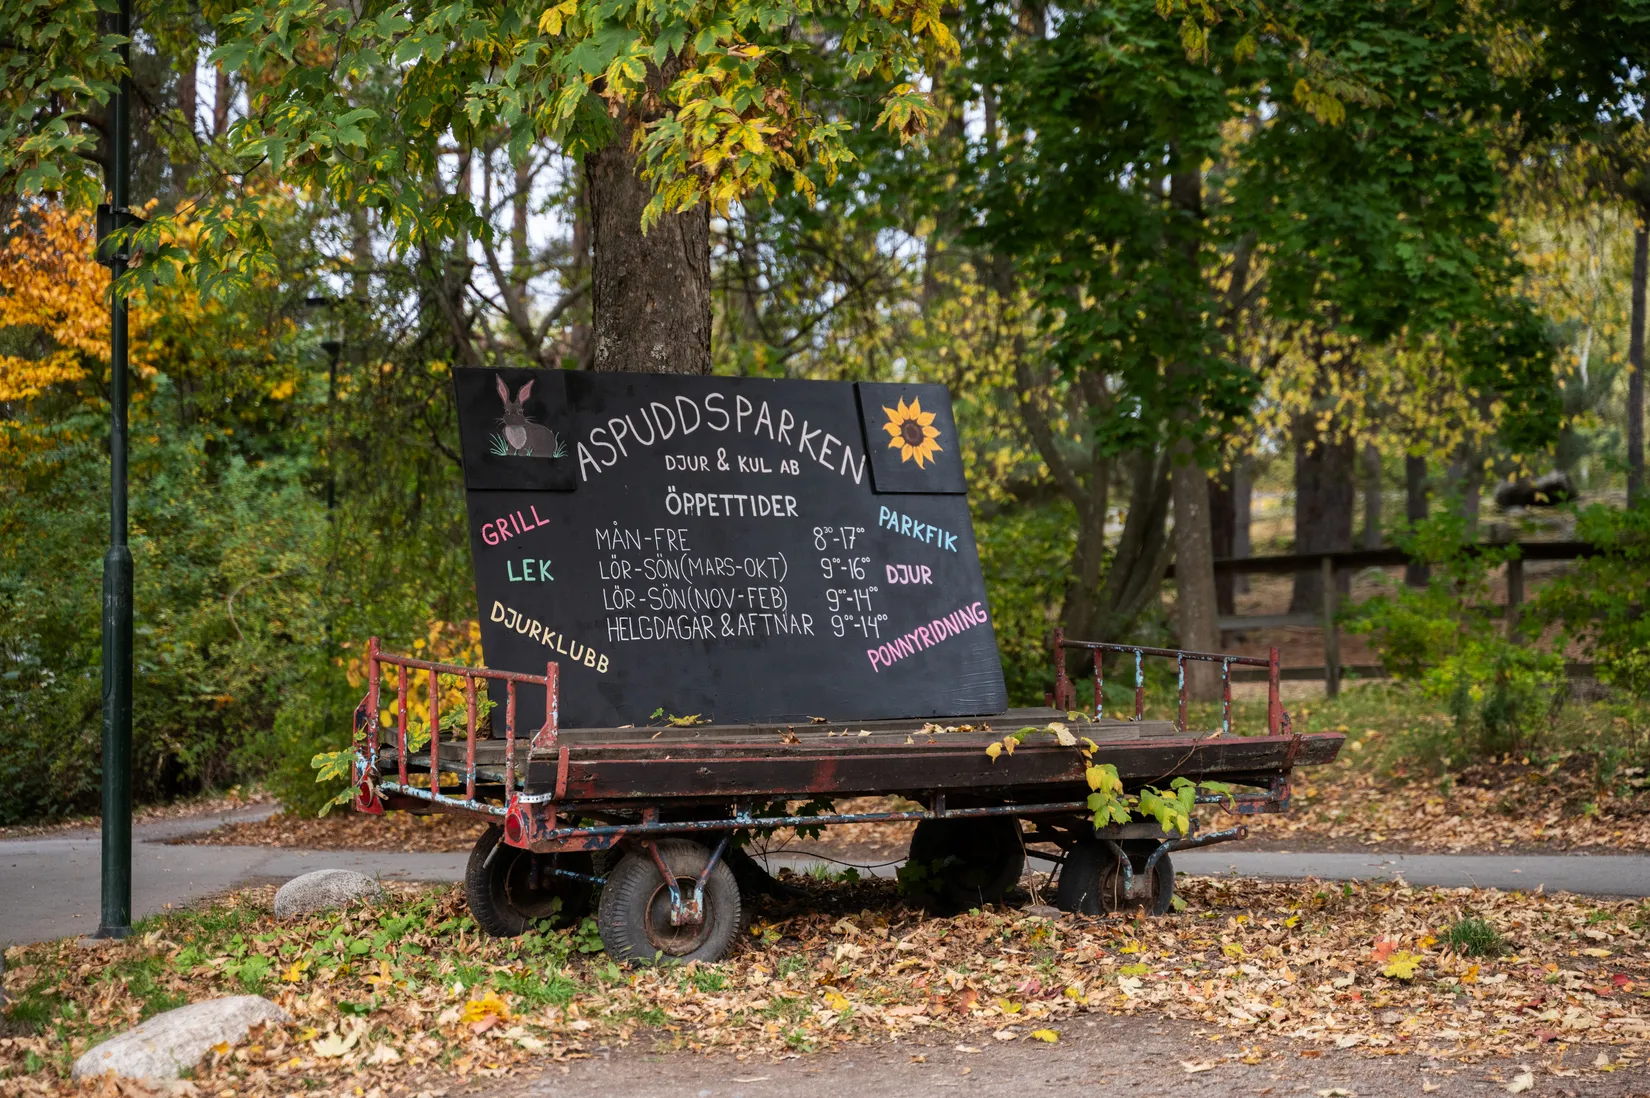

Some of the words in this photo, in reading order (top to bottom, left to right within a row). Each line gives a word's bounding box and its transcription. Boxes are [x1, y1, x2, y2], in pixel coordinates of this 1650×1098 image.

[577, 392, 866, 485] ASPUDDSPARKEN
[665, 454, 710, 472] DJUR
[717, 447, 730, 471] &
[738, 455, 772, 473] KUL
[780, 459, 800, 475] AB
[665, 485, 799, 517] ÖPPETTIDER
[481, 505, 550, 546] GRILL
[595, 520, 691, 552] MÅN-FRE
[878, 506, 958, 552] PARKFIK
[507, 558, 555, 582] LEK
[885, 564, 933, 585] DJUR
[490, 600, 610, 674] DJURKLUBB
[606, 615, 717, 642] HELGDAGAR
[737, 613, 815, 637] AFTNAR
[866, 601, 988, 673] PONNYRIDNING
